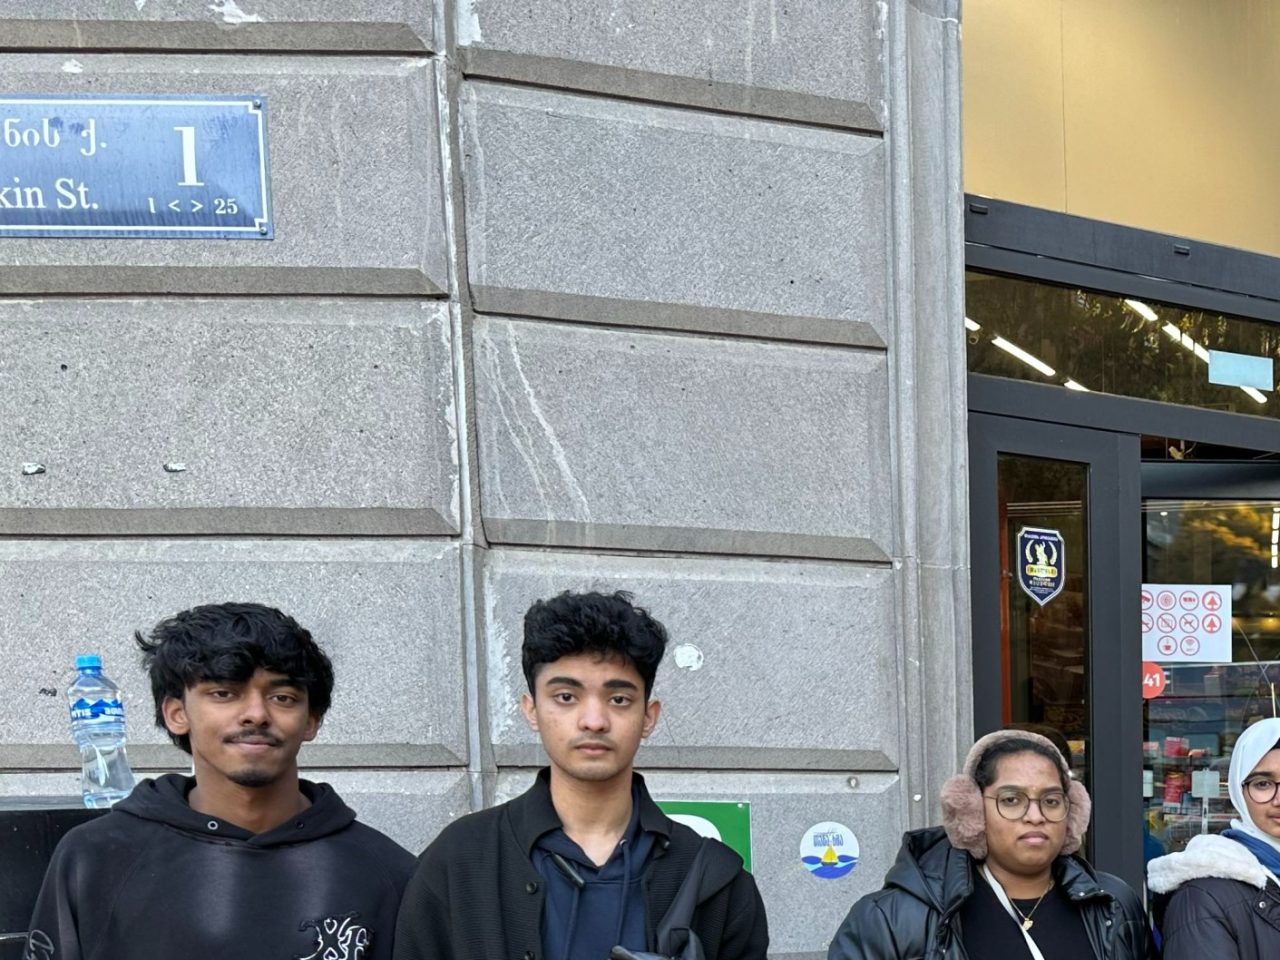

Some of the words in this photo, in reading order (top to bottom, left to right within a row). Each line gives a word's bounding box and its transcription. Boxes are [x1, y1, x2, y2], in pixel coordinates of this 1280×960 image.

[80, 118, 108, 156] ქ.
[173, 126, 205, 187] 1
[55, 178, 100, 210] St.
[214, 198, 239, 214] 25
